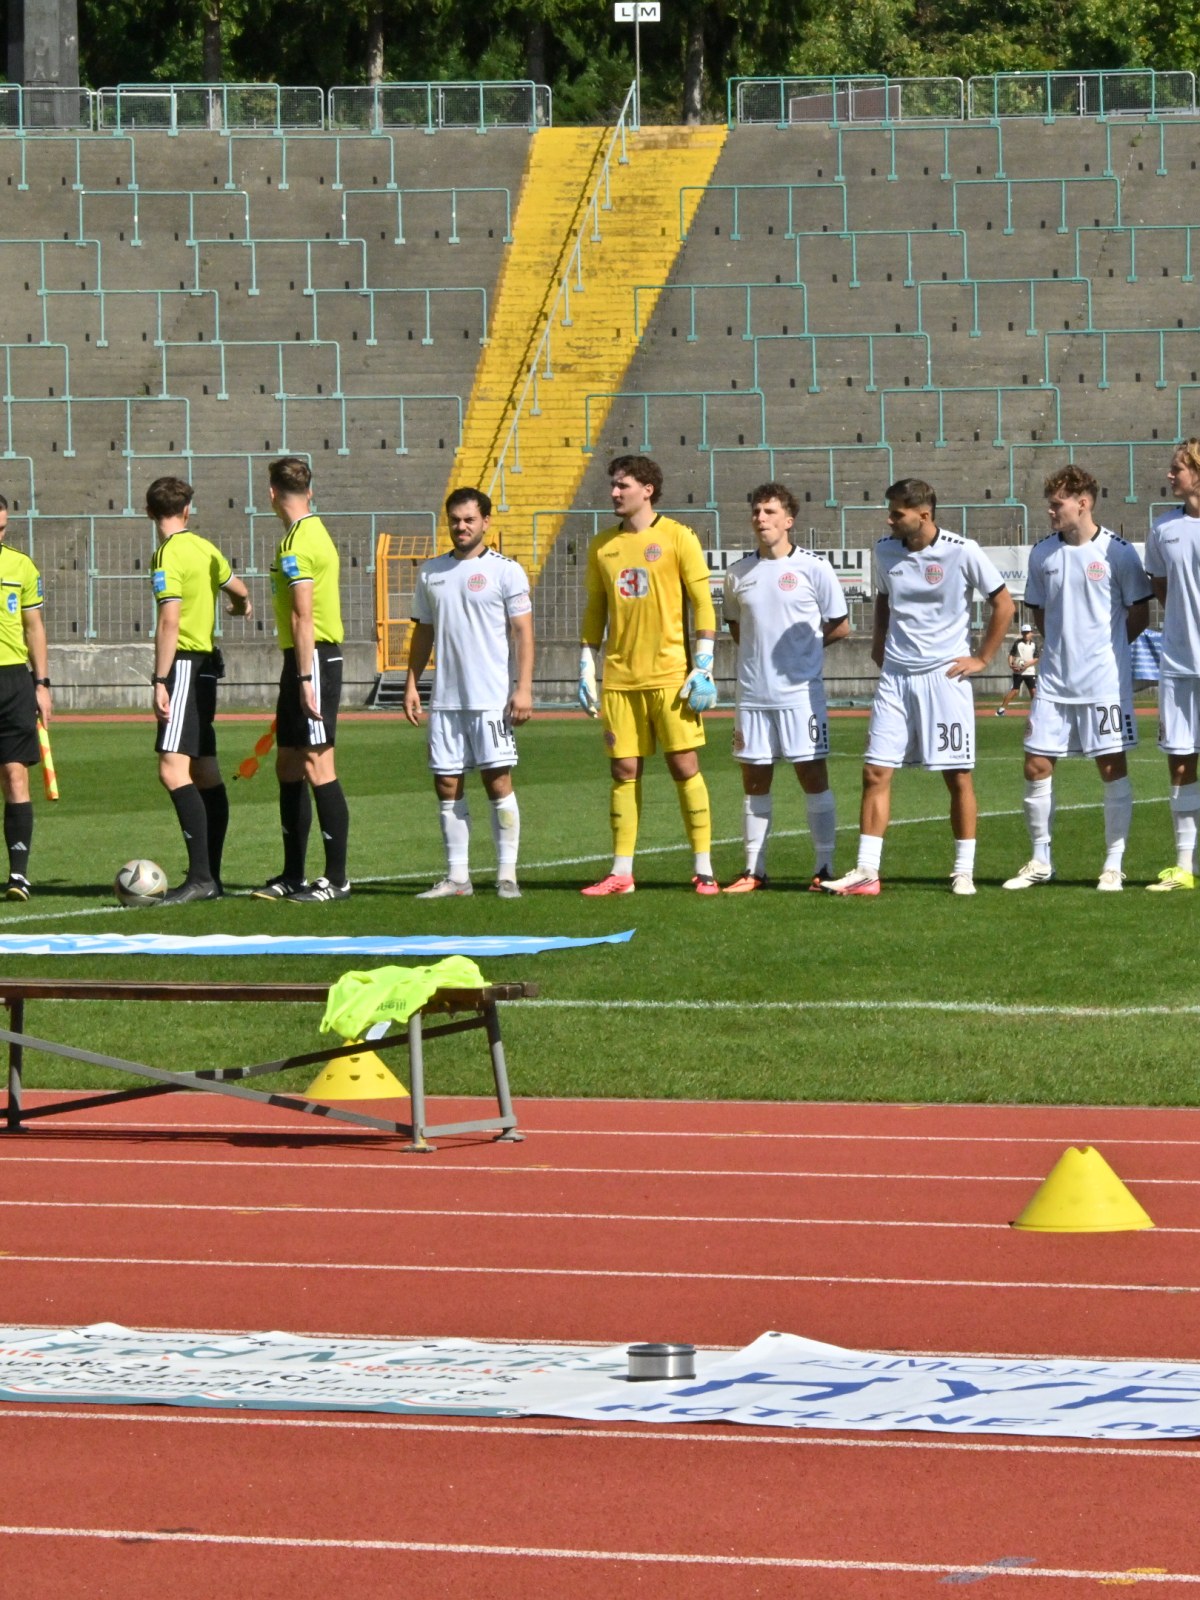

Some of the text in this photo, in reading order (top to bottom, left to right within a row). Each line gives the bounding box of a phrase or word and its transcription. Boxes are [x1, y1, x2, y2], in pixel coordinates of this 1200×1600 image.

[487, 720, 510, 748] 14
[808, 713, 820, 743] 6
[1096, 704, 1123, 735] 20
[936, 722, 963, 752] 30
